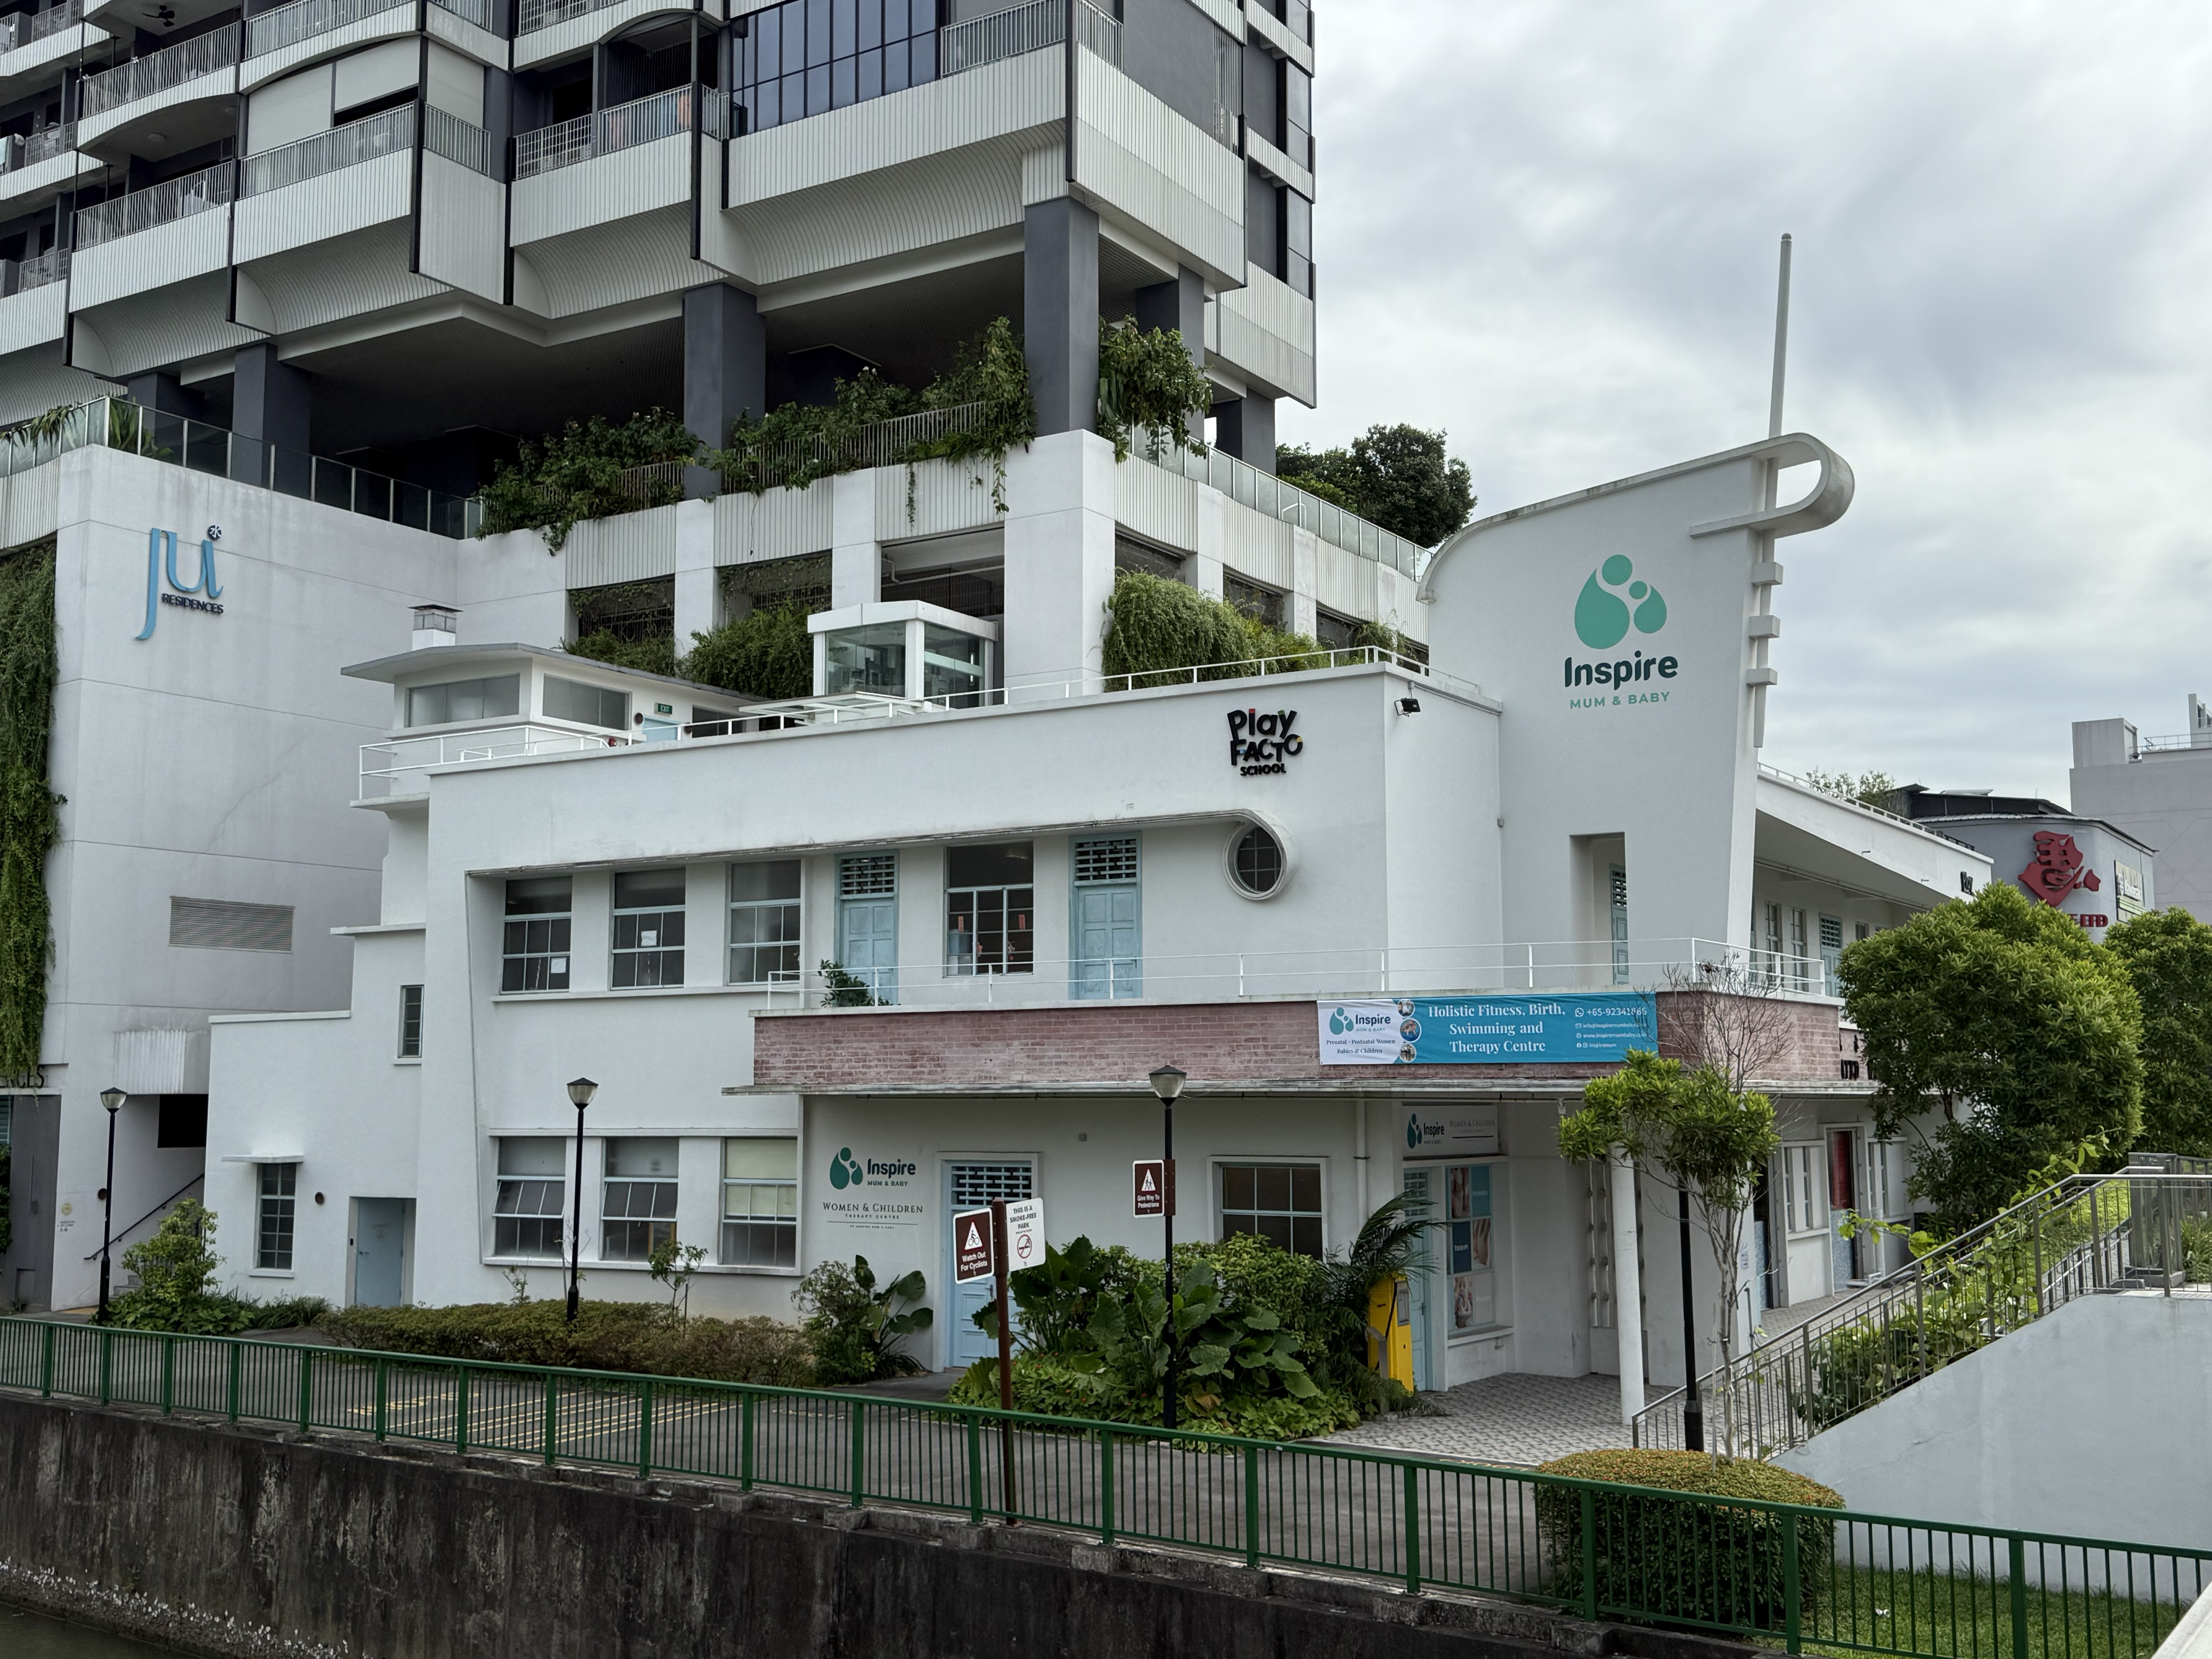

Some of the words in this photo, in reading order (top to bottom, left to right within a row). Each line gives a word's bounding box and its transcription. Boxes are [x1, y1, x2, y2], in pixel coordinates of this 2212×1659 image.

[162, 593, 223, 614] RESIDENCES
[1565, 650, 1678, 690] Inspire
[1570, 697, 1605, 709] MUM
[1612, 696, 1621, 705] &
[1628, 692, 1670, 704] BABY
[1227, 708, 1297, 740] Play
[1230, 734, 1303, 766] FACTO
[1240, 763, 1286, 776] SCHOOL
[1428, 1005, 1475, 1017] Holistic
[1478, 1004, 1525, 1017] Fitness,
[1529, 1003, 1565, 1016] Birth,
[1355, 1014, 1391, 1026] Inspire
[1449, 1022, 1515, 1036] Swimming
[1520, 1021, 1543, 1033] and
[1449, 1041, 1500, 1054] Therapy
[1504, 1040, 1545, 1052] Centre
[1424, 1122, 1444, 1138] Inspire
[867, 1159, 916, 1179] Inspire
[823, 1202, 859, 1211] WOMEN
[863, 1203, 869, 1211] &
[873, 1204, 923, 1213] CHILDREN
[1010, 1212, 1037, 1223] SMOKE-FREE
[962, 1253, 977, 1262] Watch
[969, 1261, 988, 1270] Cyclists
